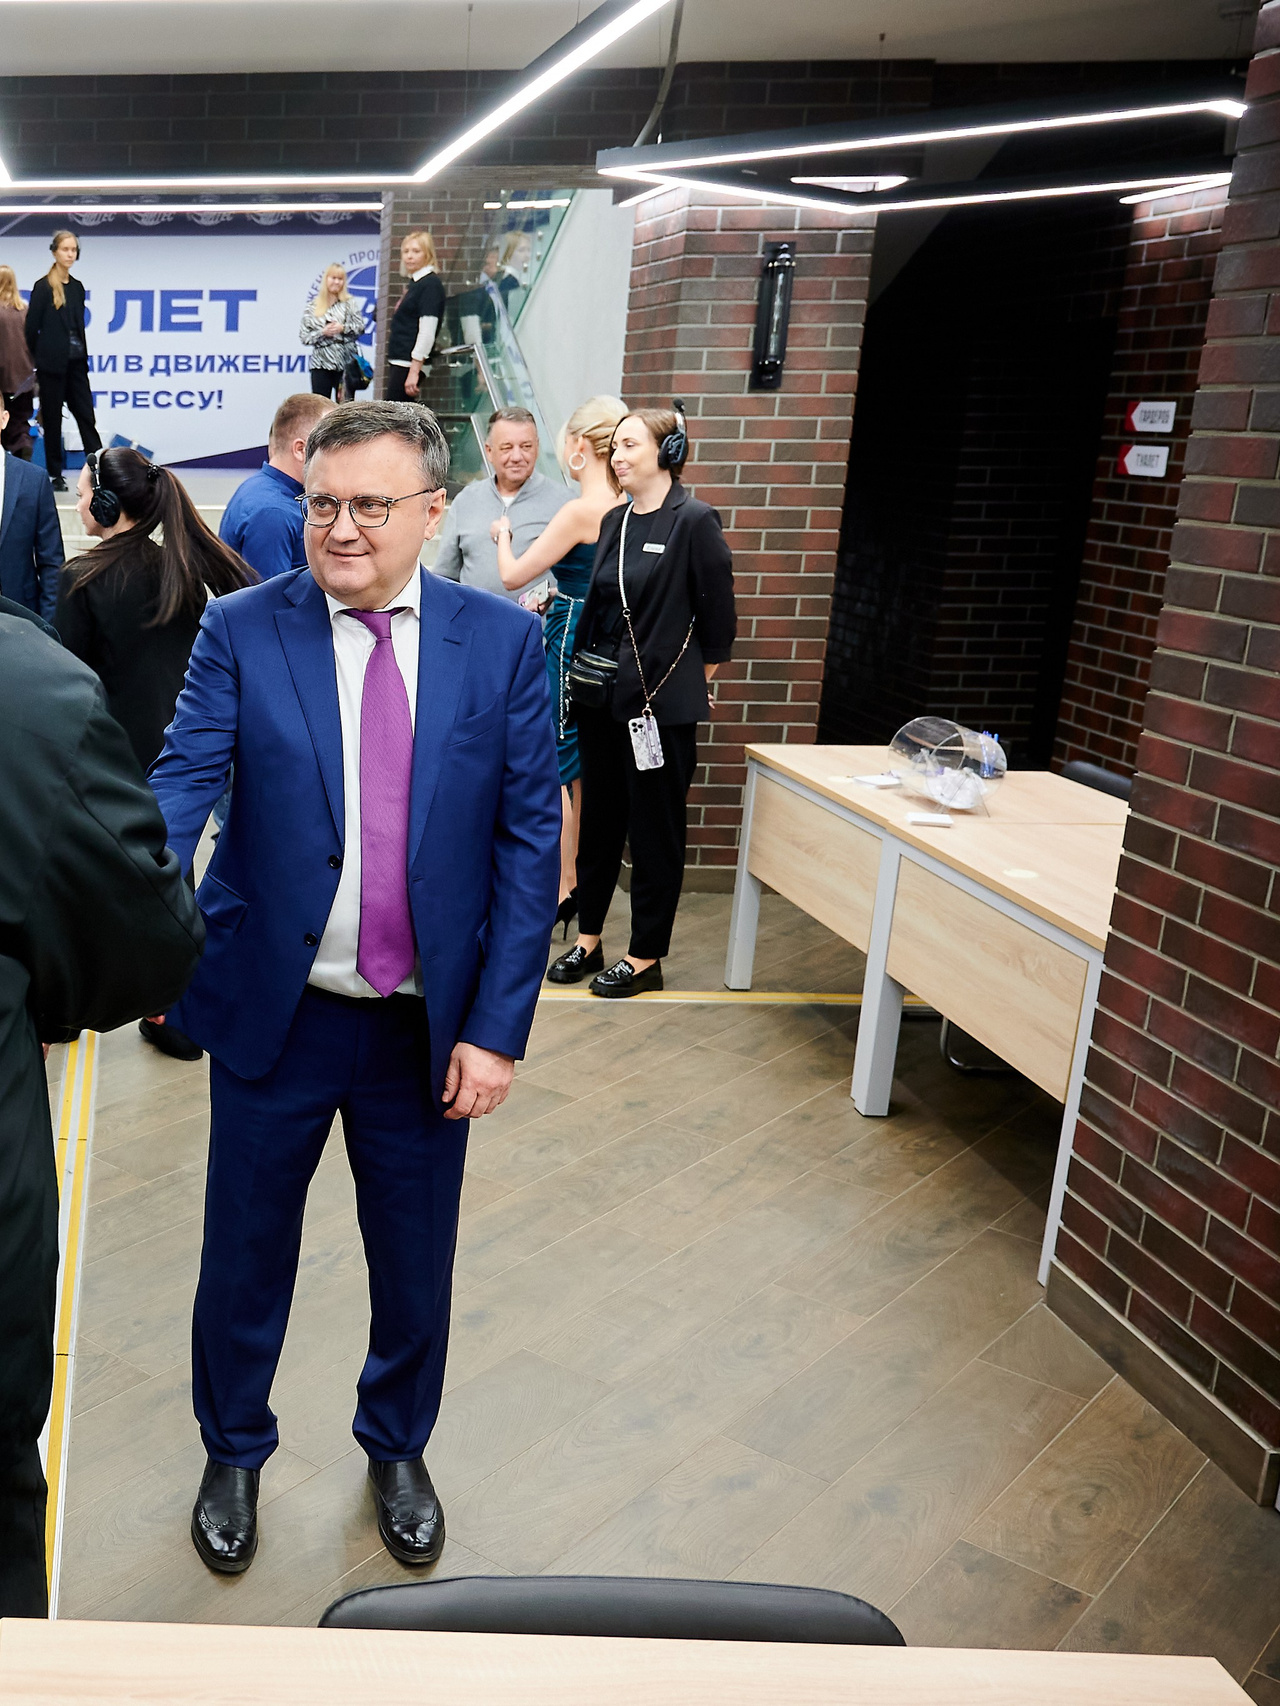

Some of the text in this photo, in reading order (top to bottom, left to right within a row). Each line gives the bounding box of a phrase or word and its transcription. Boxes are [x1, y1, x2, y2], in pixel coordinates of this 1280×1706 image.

[108, 290, 258, 333] ЛЕТ
[125, 355, 143, 373] В
[150, 355, 312, 377] ДВИЖЕНИ
